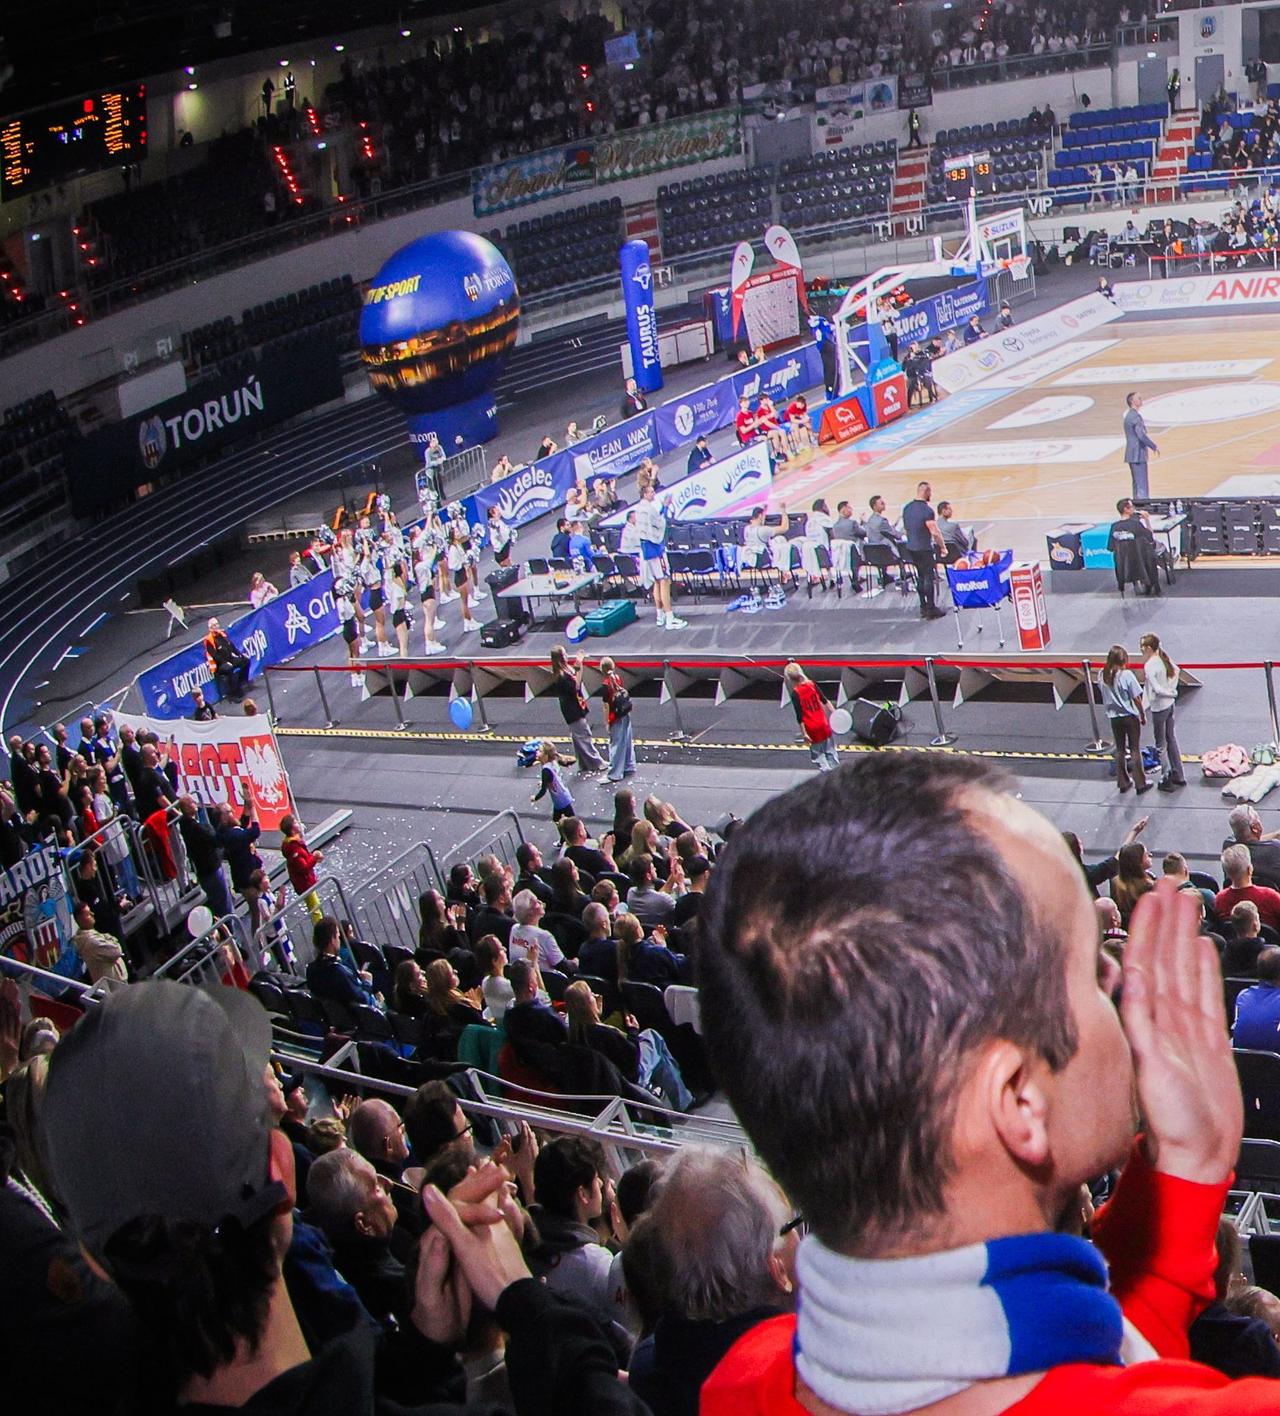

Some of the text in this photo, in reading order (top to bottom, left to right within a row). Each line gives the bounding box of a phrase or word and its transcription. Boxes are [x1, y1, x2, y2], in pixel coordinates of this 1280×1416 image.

[1027, 197, 1053, 213] VIP
[991, 218, 1018, 236] SUZUKI
[385, 275, 421, 300] SPORT
[636, 304, 656, 369] TAURUS
[165, 374, 264, 449] TORUŃ
[590, 438, 622, 463] CLEAN
[626, 424, 649, 446] WAY
[956, 580, 989, 593] molten
